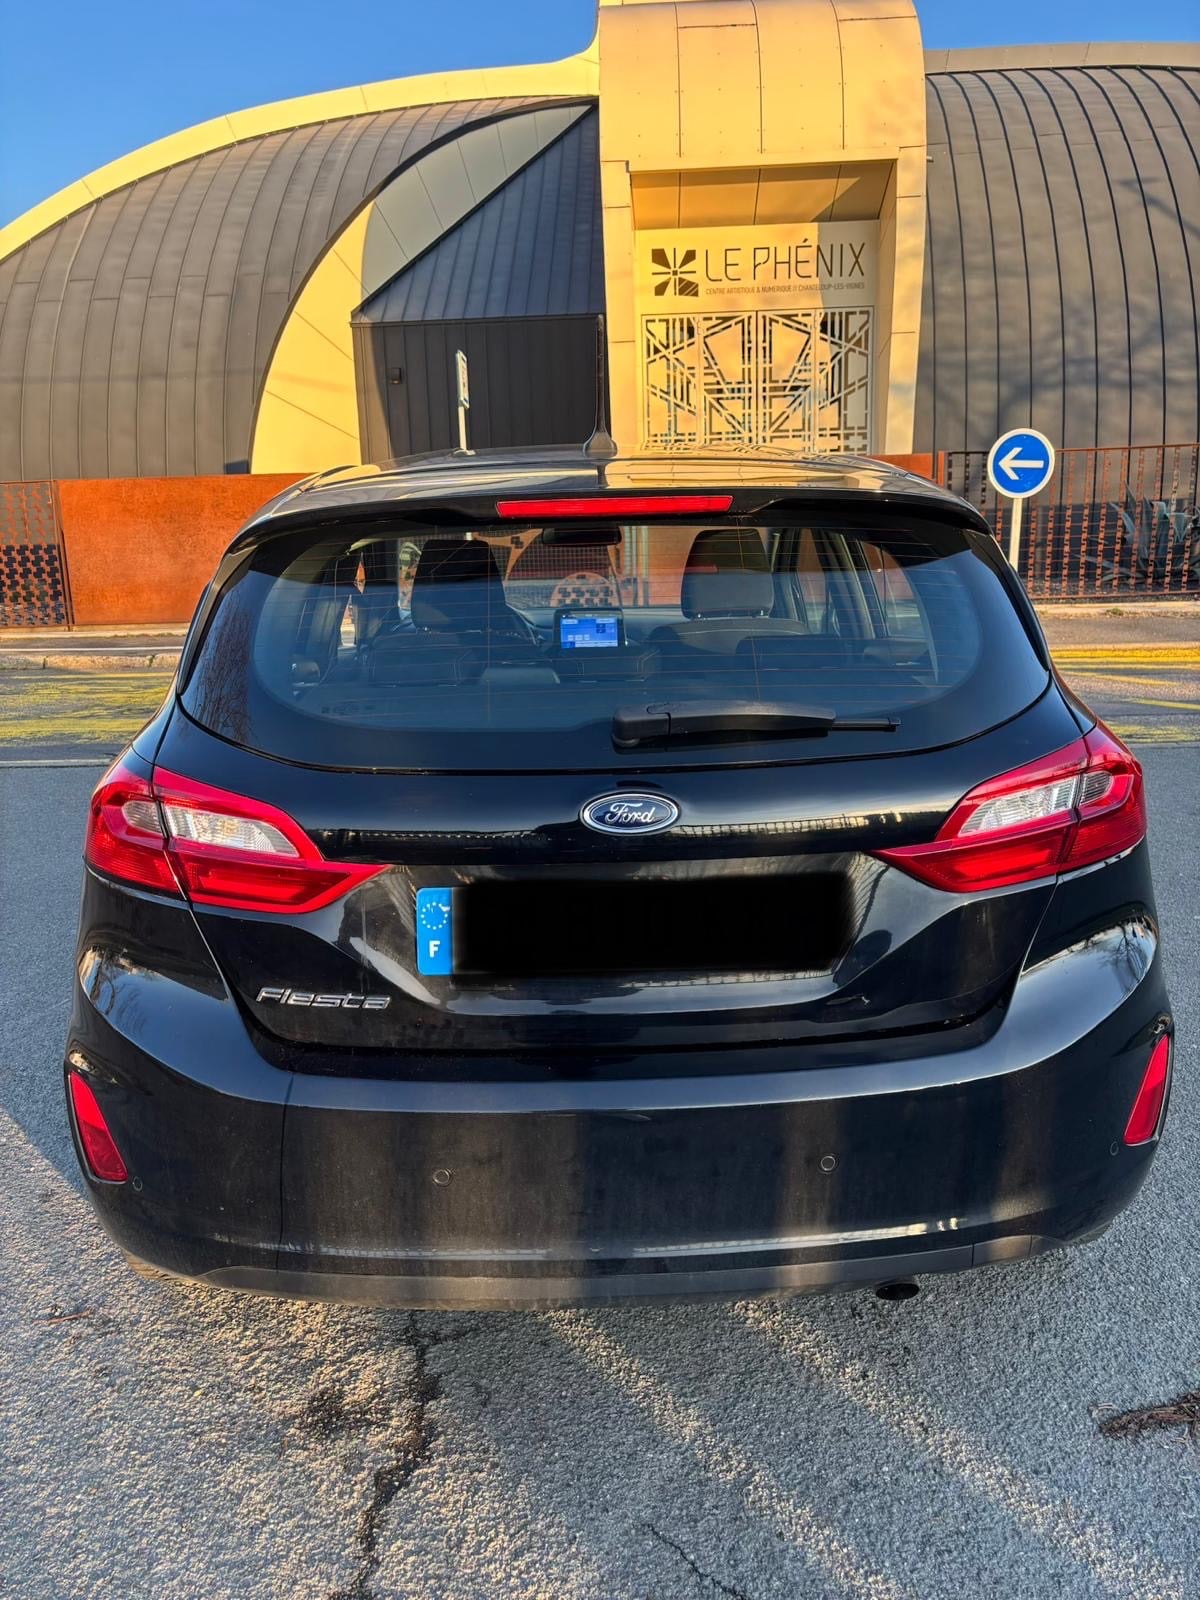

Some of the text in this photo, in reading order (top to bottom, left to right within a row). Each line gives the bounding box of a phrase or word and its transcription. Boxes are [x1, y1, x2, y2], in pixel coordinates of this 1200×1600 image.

[705, 238, 866, 282] LE PHÉNIX
[604, 802, 657, 824] Ford
[428, 940, 441, 958] F
[256, 986, 392, 1010] Fiesta
